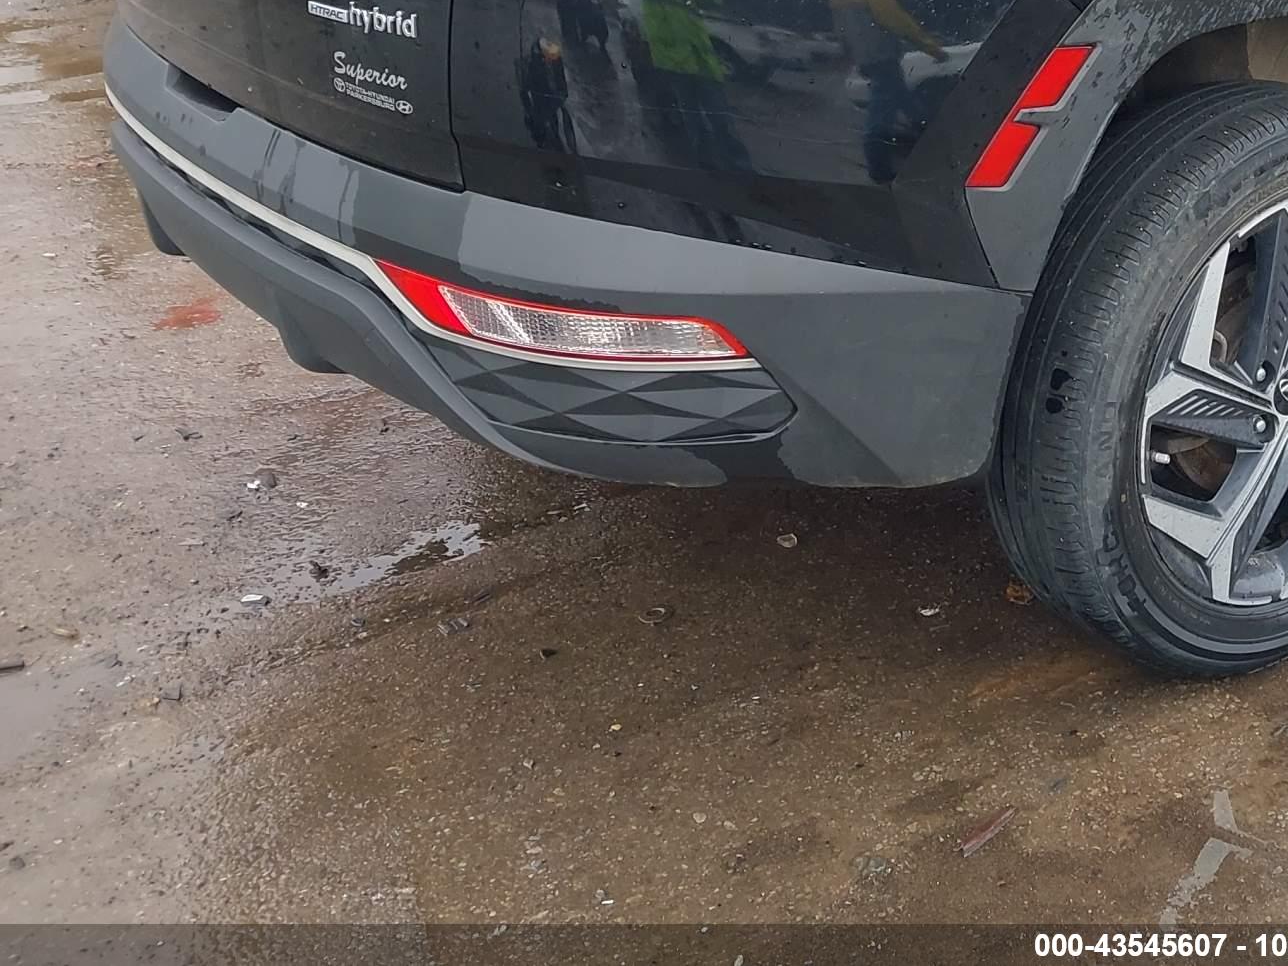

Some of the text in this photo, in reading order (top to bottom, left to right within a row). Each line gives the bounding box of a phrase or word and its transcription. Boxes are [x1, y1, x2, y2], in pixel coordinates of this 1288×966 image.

[309, 3, 346, 22] HTRAC
[349, 1, 417, 38] hybrid
[333, 51, 408, 90] Superior
